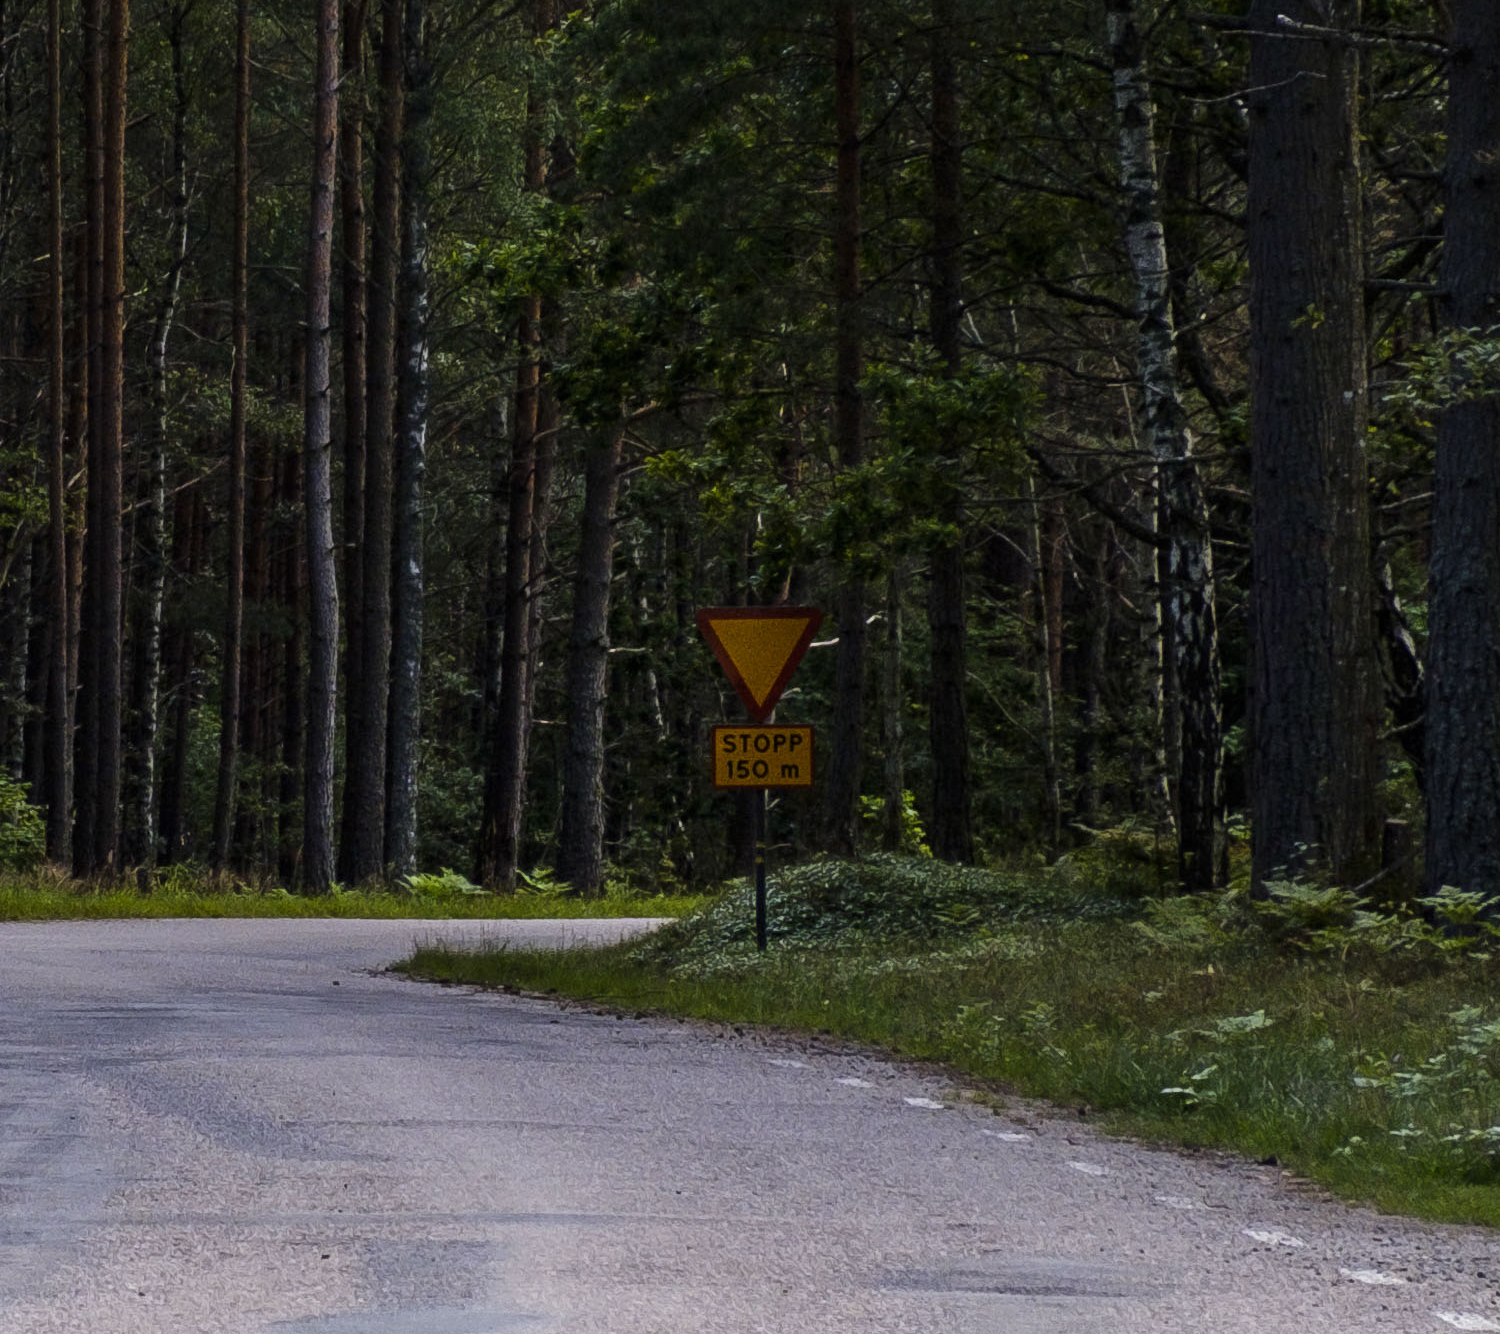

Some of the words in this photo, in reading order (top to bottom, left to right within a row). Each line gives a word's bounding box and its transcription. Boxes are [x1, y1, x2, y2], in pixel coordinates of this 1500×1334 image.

[723, 734, 803, 753] STOPP
[727, 760, 769, 779] 150
[781, 763, 800, 779] m
